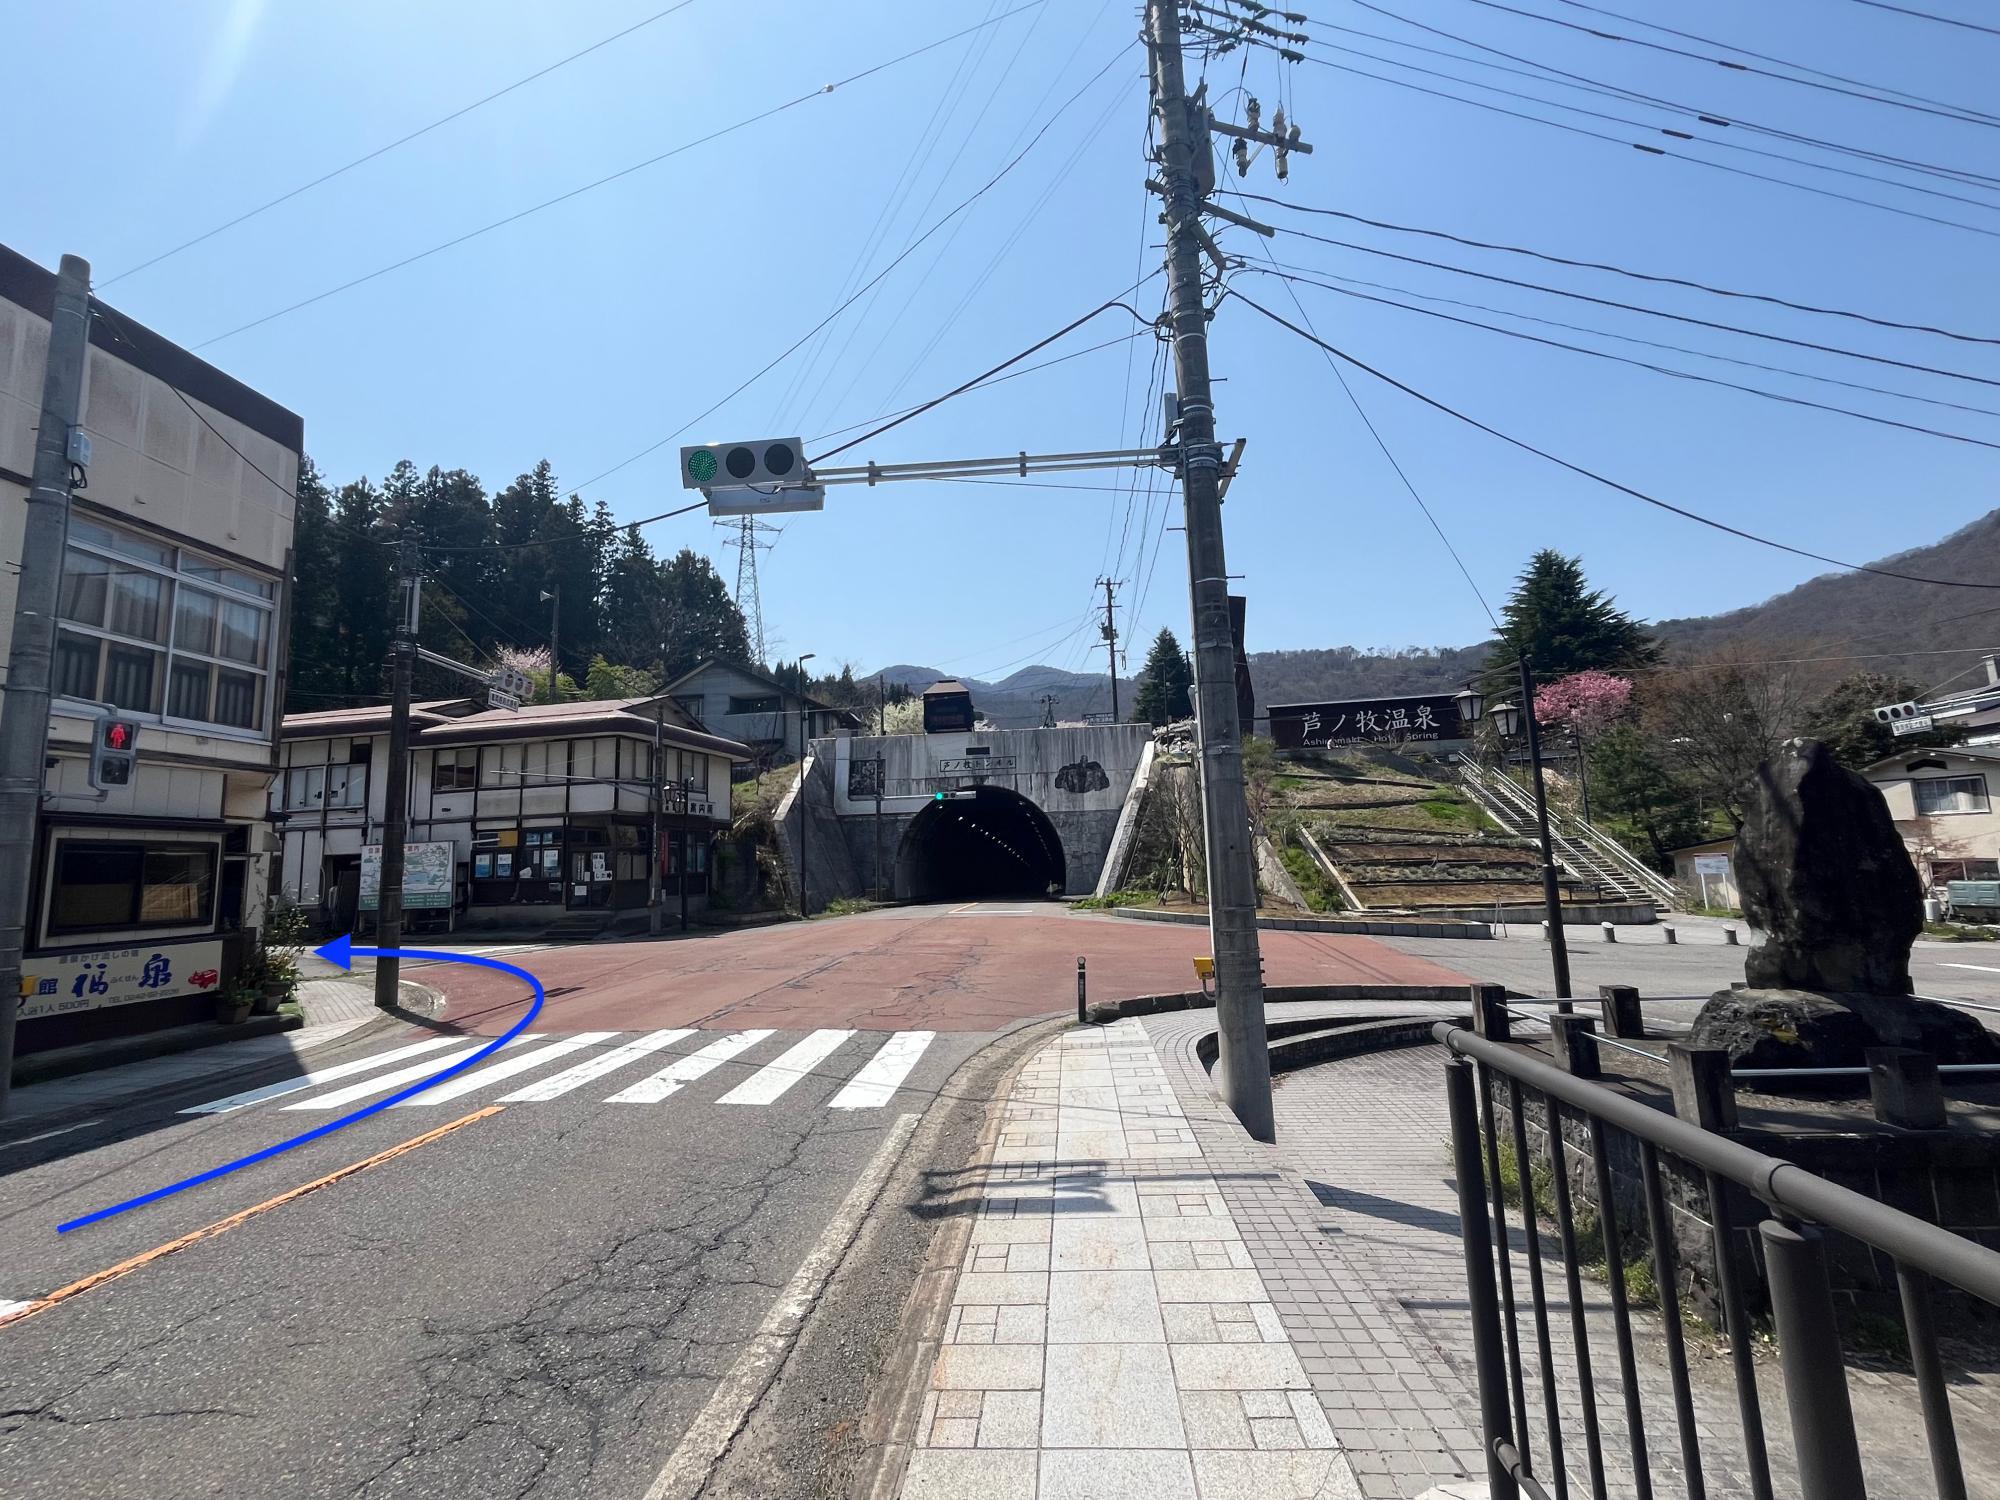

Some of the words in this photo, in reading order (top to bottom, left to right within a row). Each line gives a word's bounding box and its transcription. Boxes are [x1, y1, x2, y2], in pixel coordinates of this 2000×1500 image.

[1302, 705, 1441, 738] 芦ノ牧温泉
[1406, 732, 1439, 741] Spring
